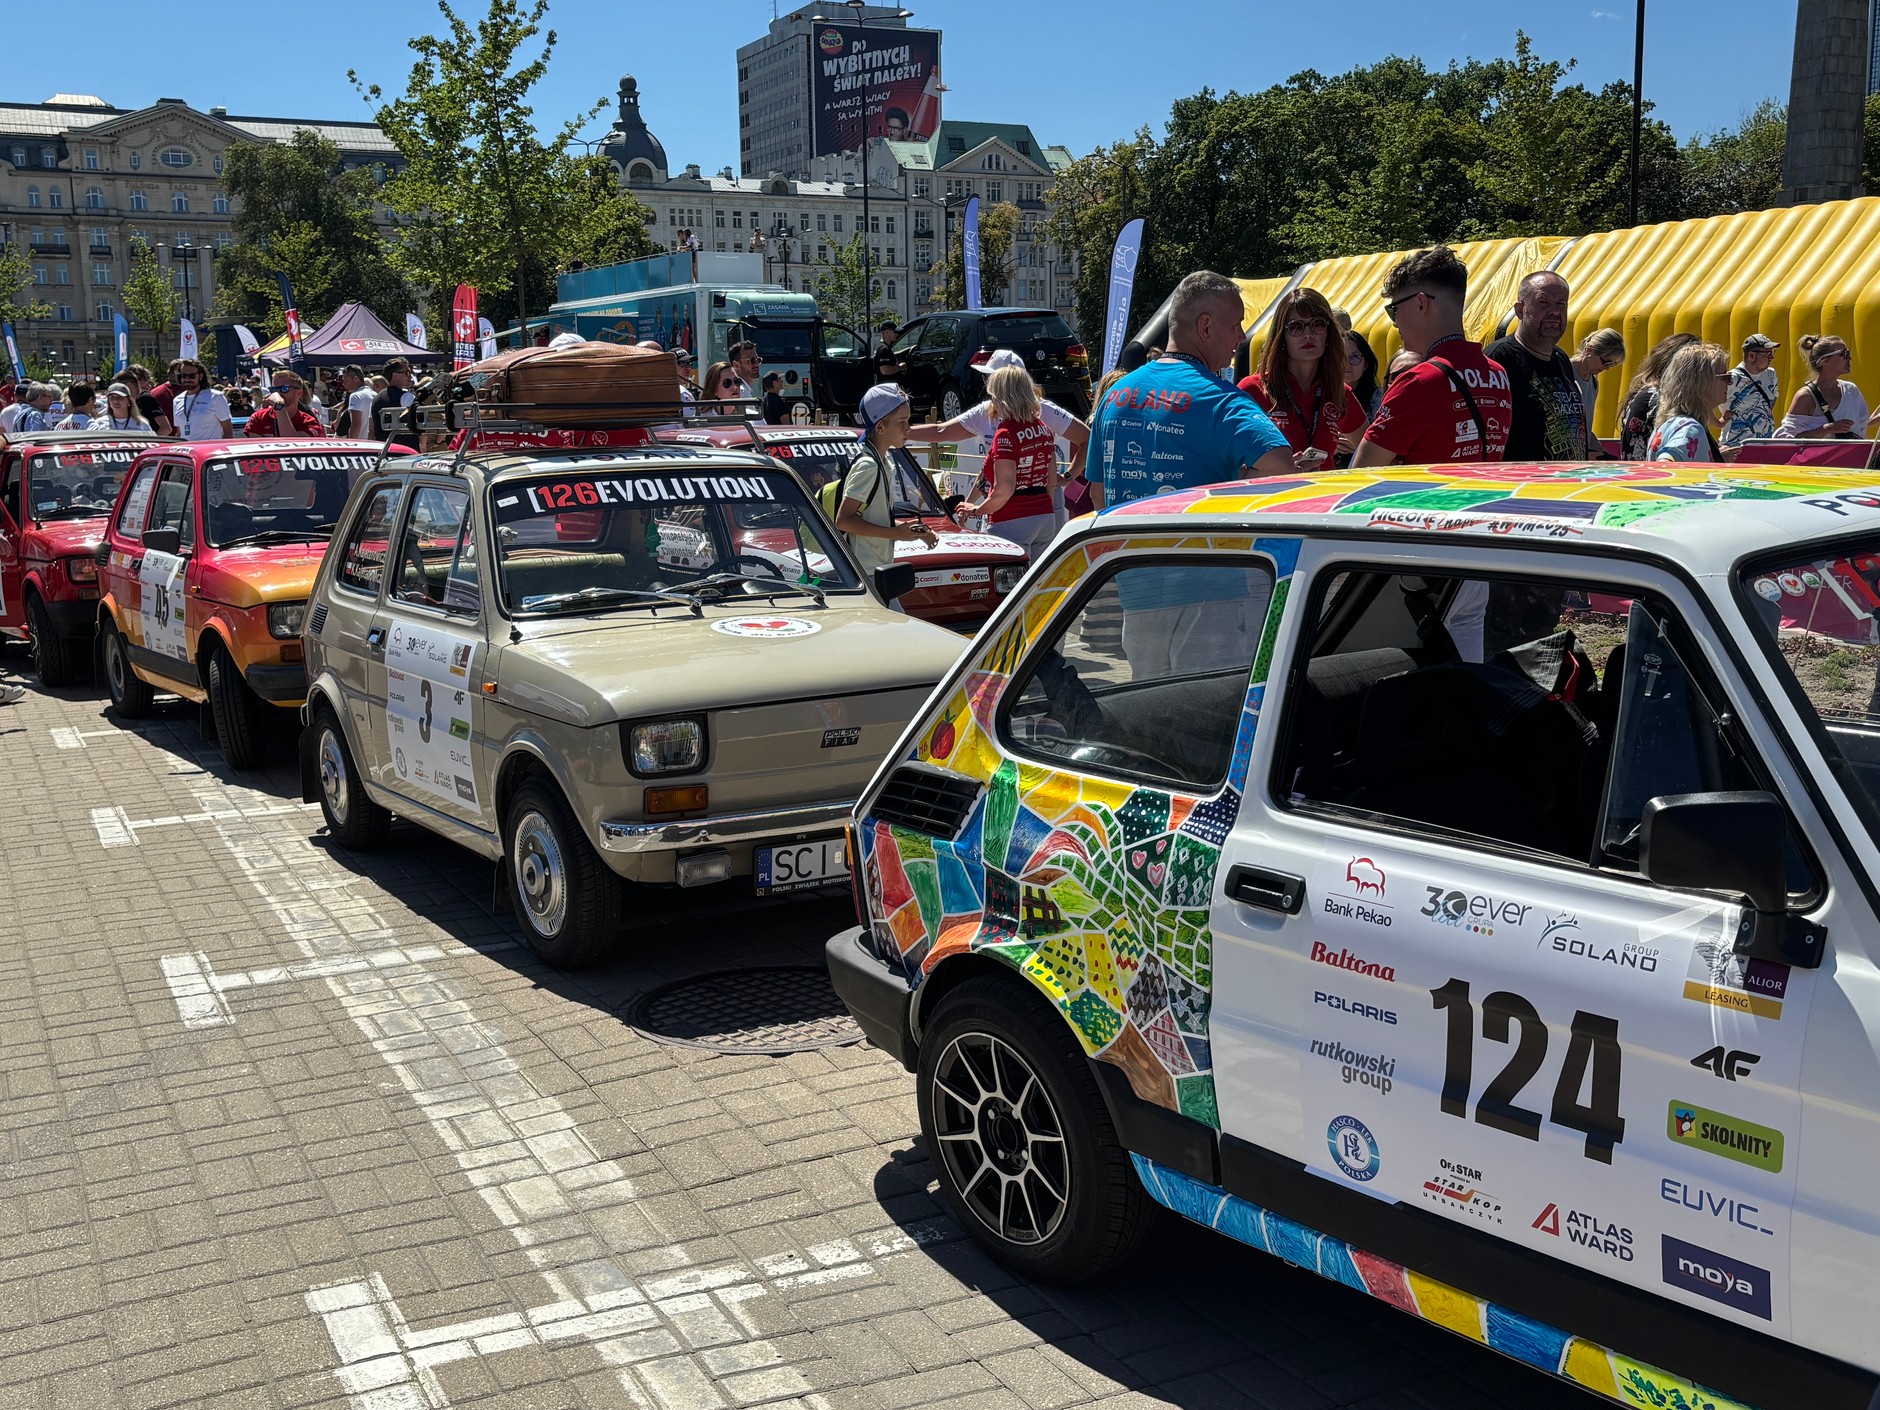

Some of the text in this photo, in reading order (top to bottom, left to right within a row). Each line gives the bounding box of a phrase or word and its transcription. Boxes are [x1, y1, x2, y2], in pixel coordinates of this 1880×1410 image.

[852, 40, 866, 54] DO
[823, 45, 910, 76] WYBITNYCH
[834, 73, 871, 93] ŚWIAT
[833, 91, 891, 108] WARSZWIACY
[1111, 297, 1127, 372] undacja
[1448, 368, 1510, 392] POLAN
[1105, 387, 1192, 414] POLAND
[1551, 403, 1585, 415] HACKET
[768, 430, 849, 439] POLAND
[75, 442, 160, 450] POLAND
[569, 450, 712, 463] POLAND
[1151, 451, 1184, 461] Baltona
[526, 476, 775, 514] [126EVOLUTION]
[1798, 492, 1880, 516] PO
[961, 573, 989, 582] donateo
[419, 679, 432, 744] 3
[824, 737, 856, 746] FIAT
[775, 844, 827, 882] SCI
[759, 873, 770, 882] PL
[772, 885, 792, 893] POLSKI
[822, 876, 851, 885] MOTOROW
[1325, 898, 1393, 928] Bank Pekao
[1467, 915, 1495, 929] GRUPA
[1552, 936, 1658, 973] SOLANO
[1623, 943, 1660, 958] GROUP
[1310, 941, 1396, 983] Baltona
[1747, 975, 1783, 991] ALIOR
[1314, 991, 1398, 1026] POLARIS
[1704, 990, 1749, 1009] LEASING
[1310, 1039, 1396, 1078] rutkowski
[1690, 1045, 1761, 1082] 4F
[1341, 1064, 1392, 1096] group
[1429, 977, 1626, 1166] 124
[1330, 1117, 1356, 1133] HASCO
[1700, 1121, 1772, 1159] SKOLNITY
[1337, 1160, 1373, 1181] POLSKA
[1433, 1176, 1465, 1192] STAR
[1472, 1197, 1502, 1212] KOP
[1566, 1210, 1634, 1245] ATLAS
[1566, 1226, 1634, 1262] WARD
[1678, 1257, 1753, 1296] moya
